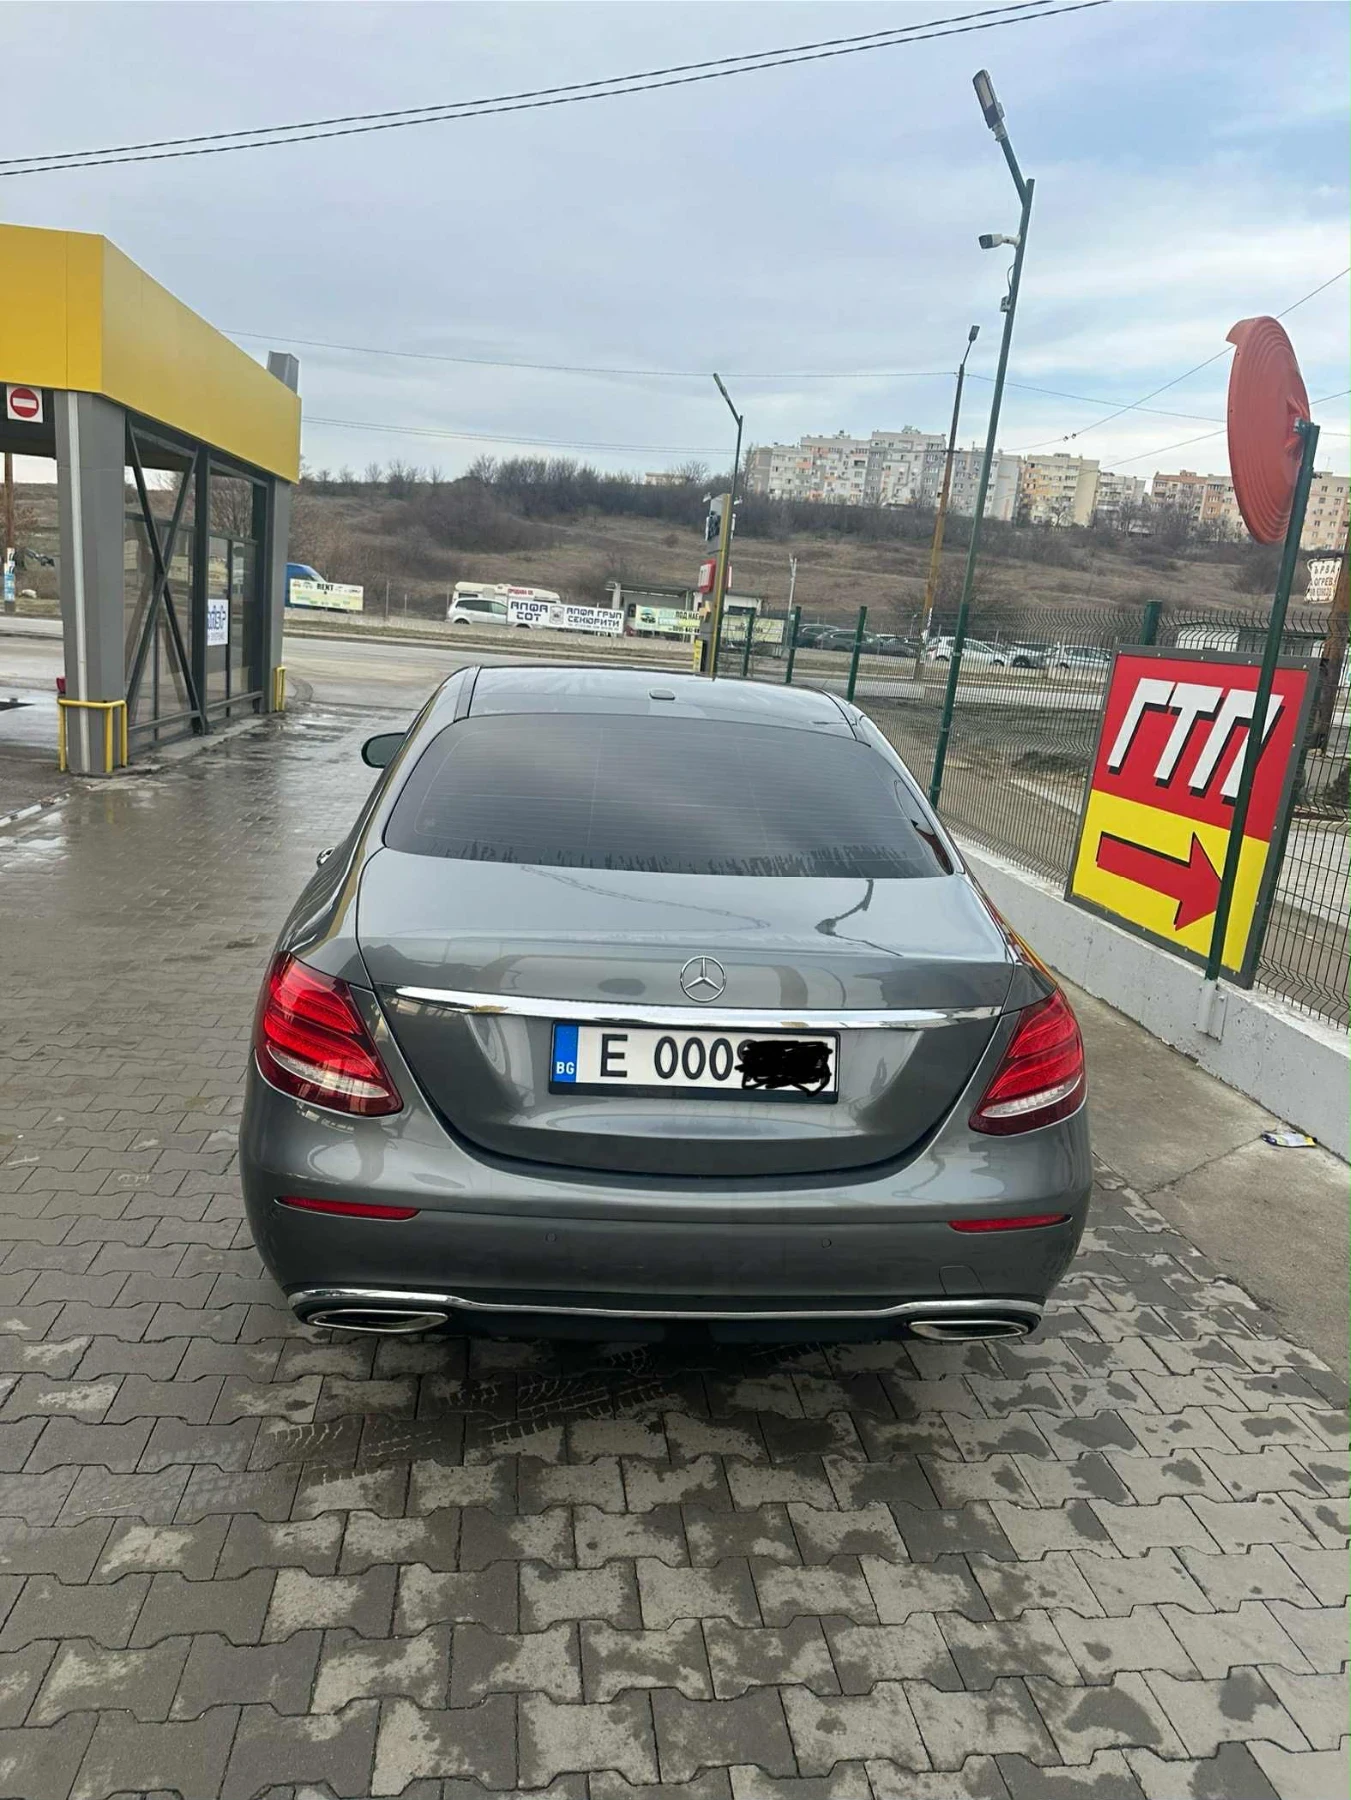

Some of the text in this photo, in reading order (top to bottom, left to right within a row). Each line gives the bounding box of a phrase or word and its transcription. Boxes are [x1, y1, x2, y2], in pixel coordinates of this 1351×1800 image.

[516, 611, 541, 621] СОТ
[597, 610, 622, 619] ГРУП
[567, 615, 620, 627] СЕКЮРИТИ
[600, 1033, 757, 1082] E 000
[556, 1061, 575, 1075] BG
